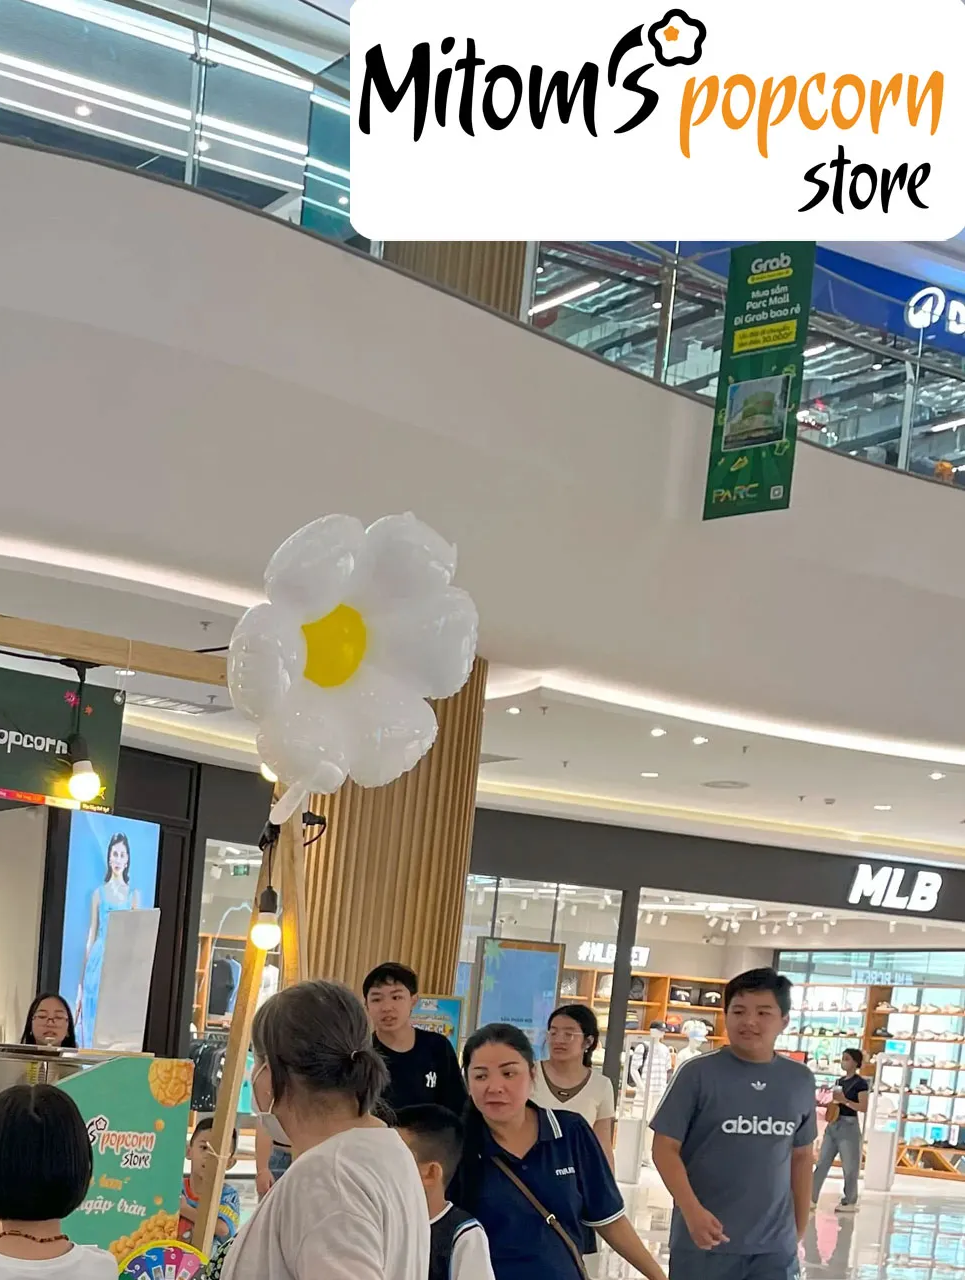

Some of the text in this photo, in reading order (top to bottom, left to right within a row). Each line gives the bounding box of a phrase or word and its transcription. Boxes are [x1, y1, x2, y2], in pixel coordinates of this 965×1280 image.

[751, 252, 791, 274] Grab
[746, 293, 790, 311] Parc Mall
[751, 289, 770, 299] Mua
[745, 311, 769, 323] Grab
[770, 308, 789, 319] bao
[848, 863, 943, 912] MLB
[721, 1115, 796, 1136] abidas
[100, 1132, 155, 1152] popcorn
[122, 1150, 150, 1167] store
